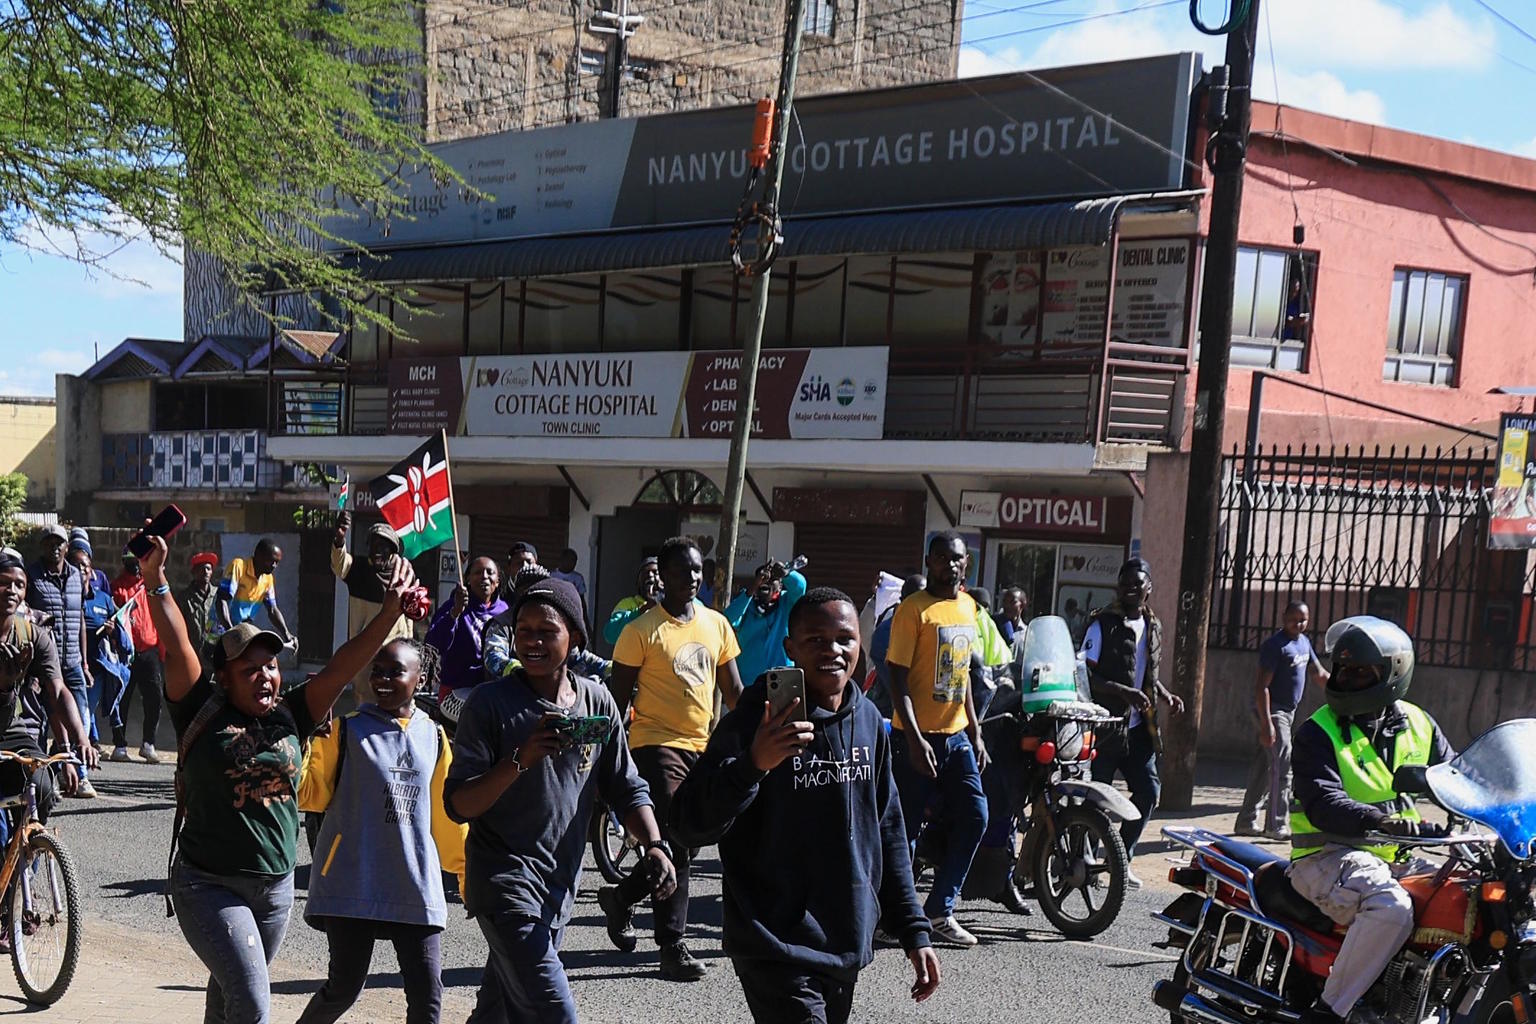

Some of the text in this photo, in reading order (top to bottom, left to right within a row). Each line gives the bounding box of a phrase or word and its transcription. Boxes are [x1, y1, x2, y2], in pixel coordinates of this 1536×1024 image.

[648, 113, 1120, 185] NANYU COTTAGE HOSPITAL
[1123, 247, 1186, 266] DENTAL CLINIC
[714, 356, 785, 369] PHAACY
[409, 366, 436, 380] MCH
[531, 360, 632, 387] NANYUKI
[713, 379, 737, 391] LAB
[800, 376, 831, 402] SHA
[495, 394, 658, 416] COTTAGE HOSPITAL
[712, 400, 759, 411] DENL
[795, 412, 878, 422] Major Cards Accepted Here
[542, 422, 600, 434] TOWN CLINIC
[710, 420, 763, 432] OPTAL
[1001, 497, 1098, 527] OPTICAL
[384, 782, 421, 799] ALBERTA
[385, 796, 417, 813] WINTER
[385, 811, 414, 826] GAMES
